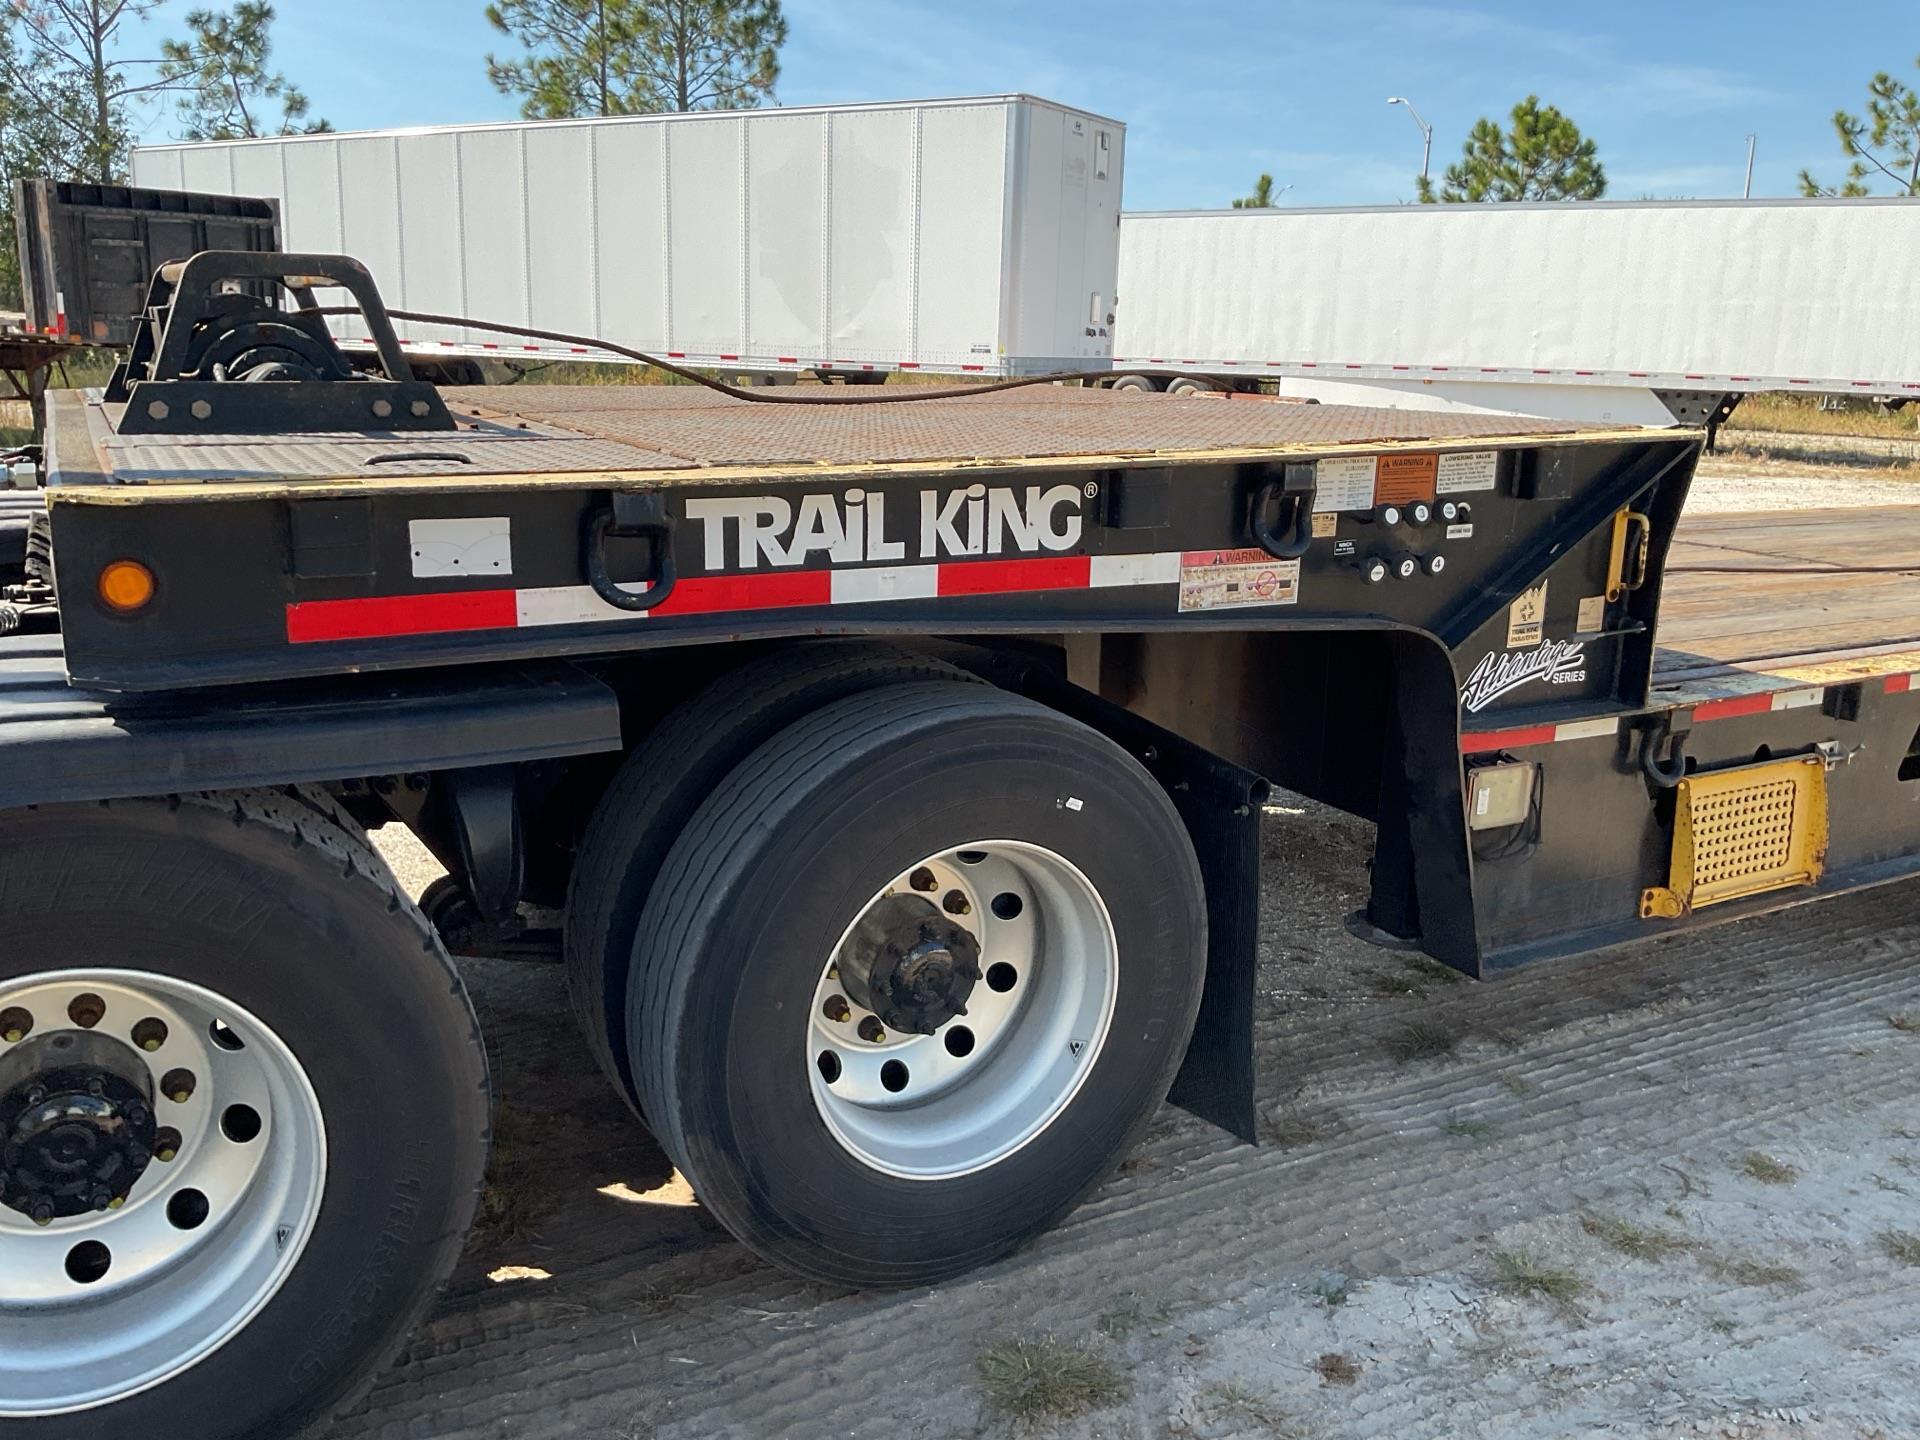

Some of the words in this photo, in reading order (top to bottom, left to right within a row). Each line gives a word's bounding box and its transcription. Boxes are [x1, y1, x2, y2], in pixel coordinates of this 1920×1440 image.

[1391, 458, 1424, 467] WARNING
[1445, 454, 1474, 462] LOWERING
[1460, 638, 1585, 713] Advantage
[1551, 670, 1587, 684] SERIES
